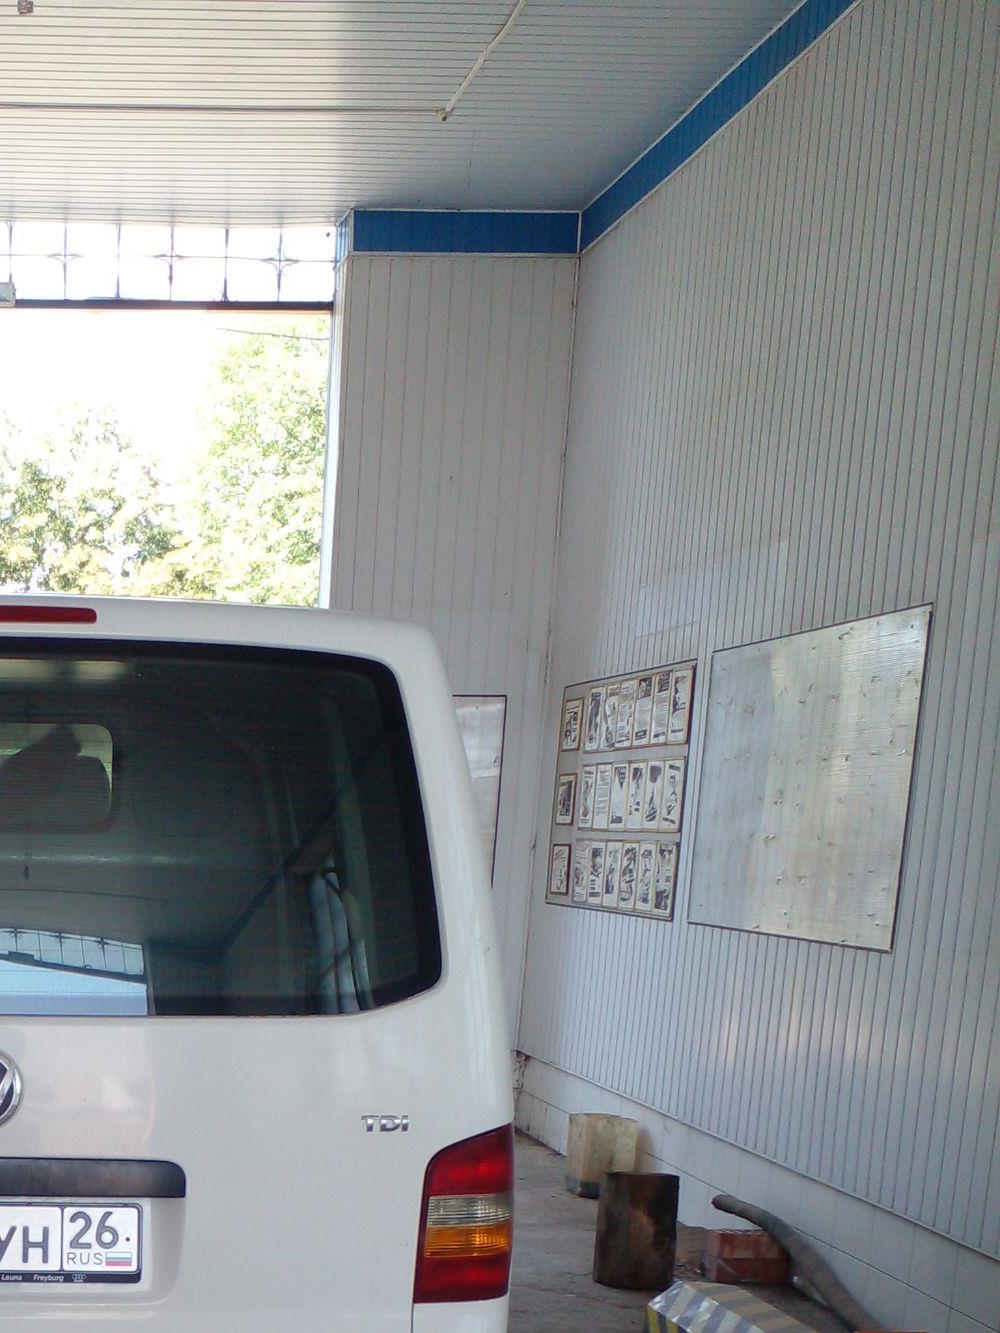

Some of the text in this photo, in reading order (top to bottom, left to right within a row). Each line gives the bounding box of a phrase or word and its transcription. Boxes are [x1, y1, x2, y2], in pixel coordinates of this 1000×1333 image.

[361, 1114, 409, 1132] TDI
[68, 1210, 120, 1250] 26
[66, 1251, 104, 1267] RUS
[33, 1274, 65, 1283] Freyburg
